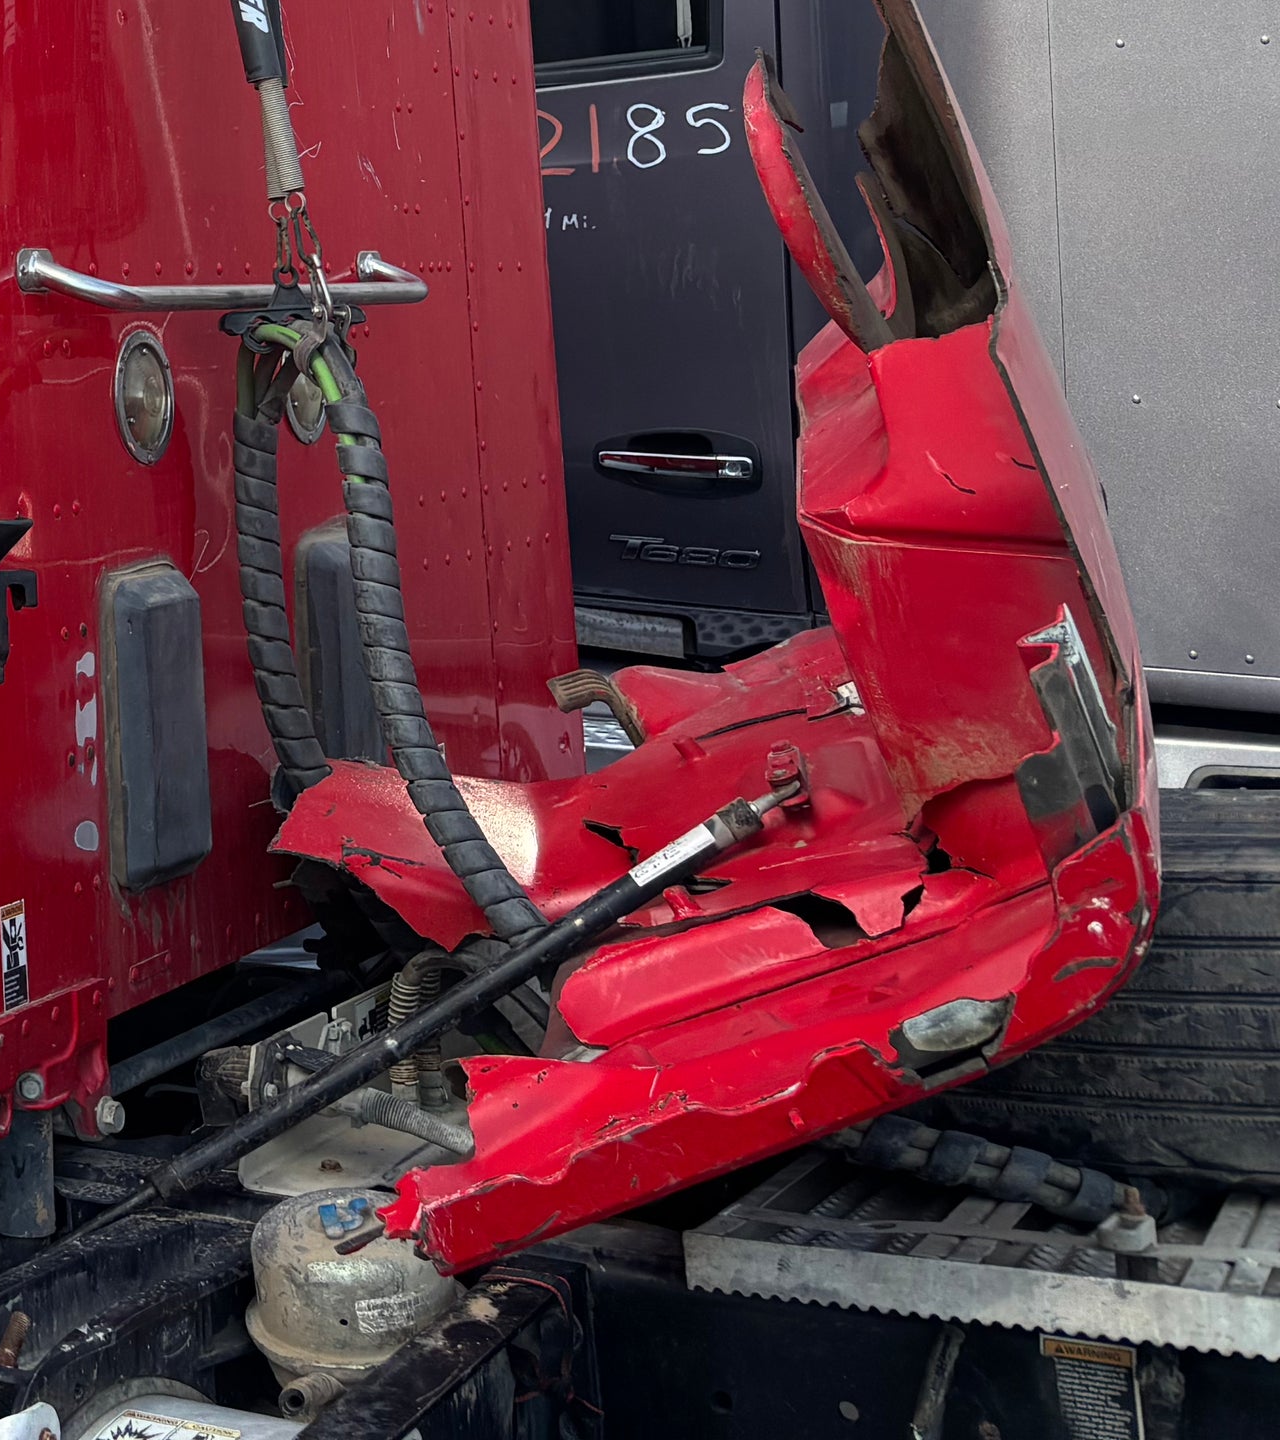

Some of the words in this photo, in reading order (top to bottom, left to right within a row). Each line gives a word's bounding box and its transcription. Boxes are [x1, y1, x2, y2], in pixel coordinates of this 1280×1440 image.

[536, 102, 732, 177] 2185
[609, 534, 761, 569] T680
[1065, 1344, 1122, 1363] WARNING
